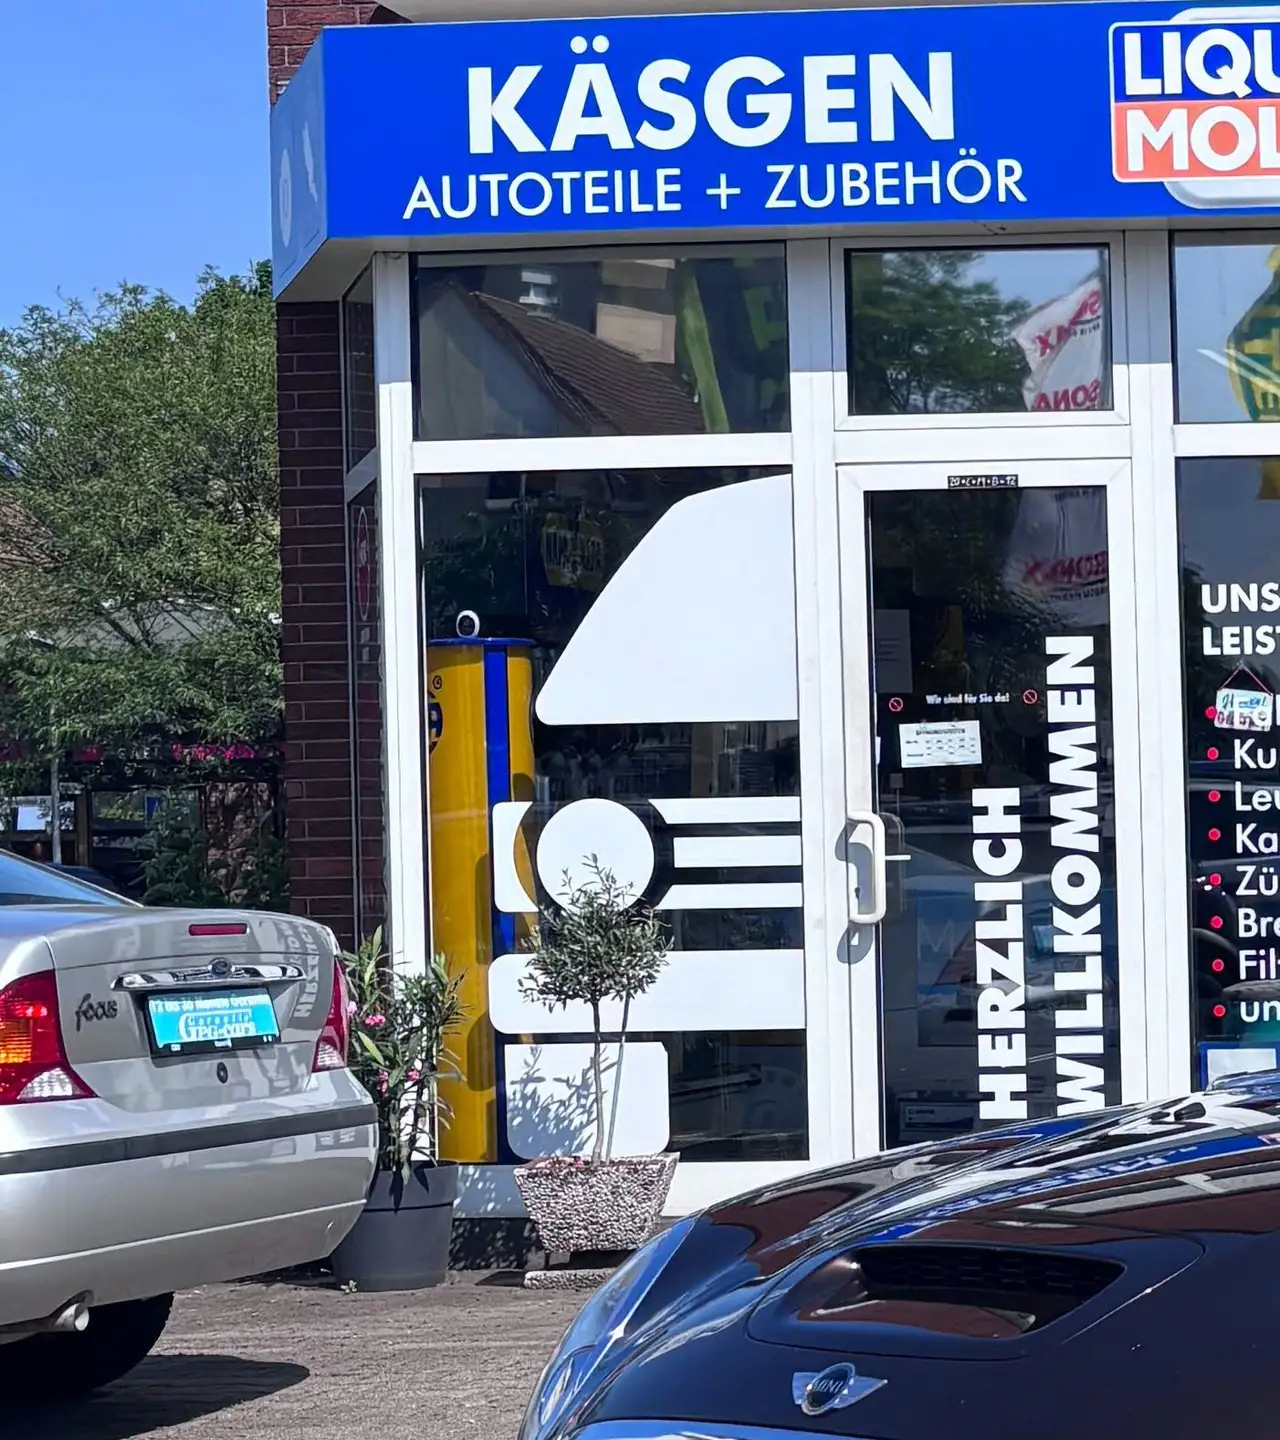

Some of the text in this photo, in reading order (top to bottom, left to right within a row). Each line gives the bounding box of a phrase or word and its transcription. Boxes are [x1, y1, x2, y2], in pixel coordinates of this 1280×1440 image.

[403, 147, 1027, 220] AUTOTEILE + ZUBEHÖR
[467, 35, 955, 154] KÄSGEN
[972, 787, 1028, 1120] HERZLICH
[1046, 636, 1106, 1117] WILLKOMMEN
